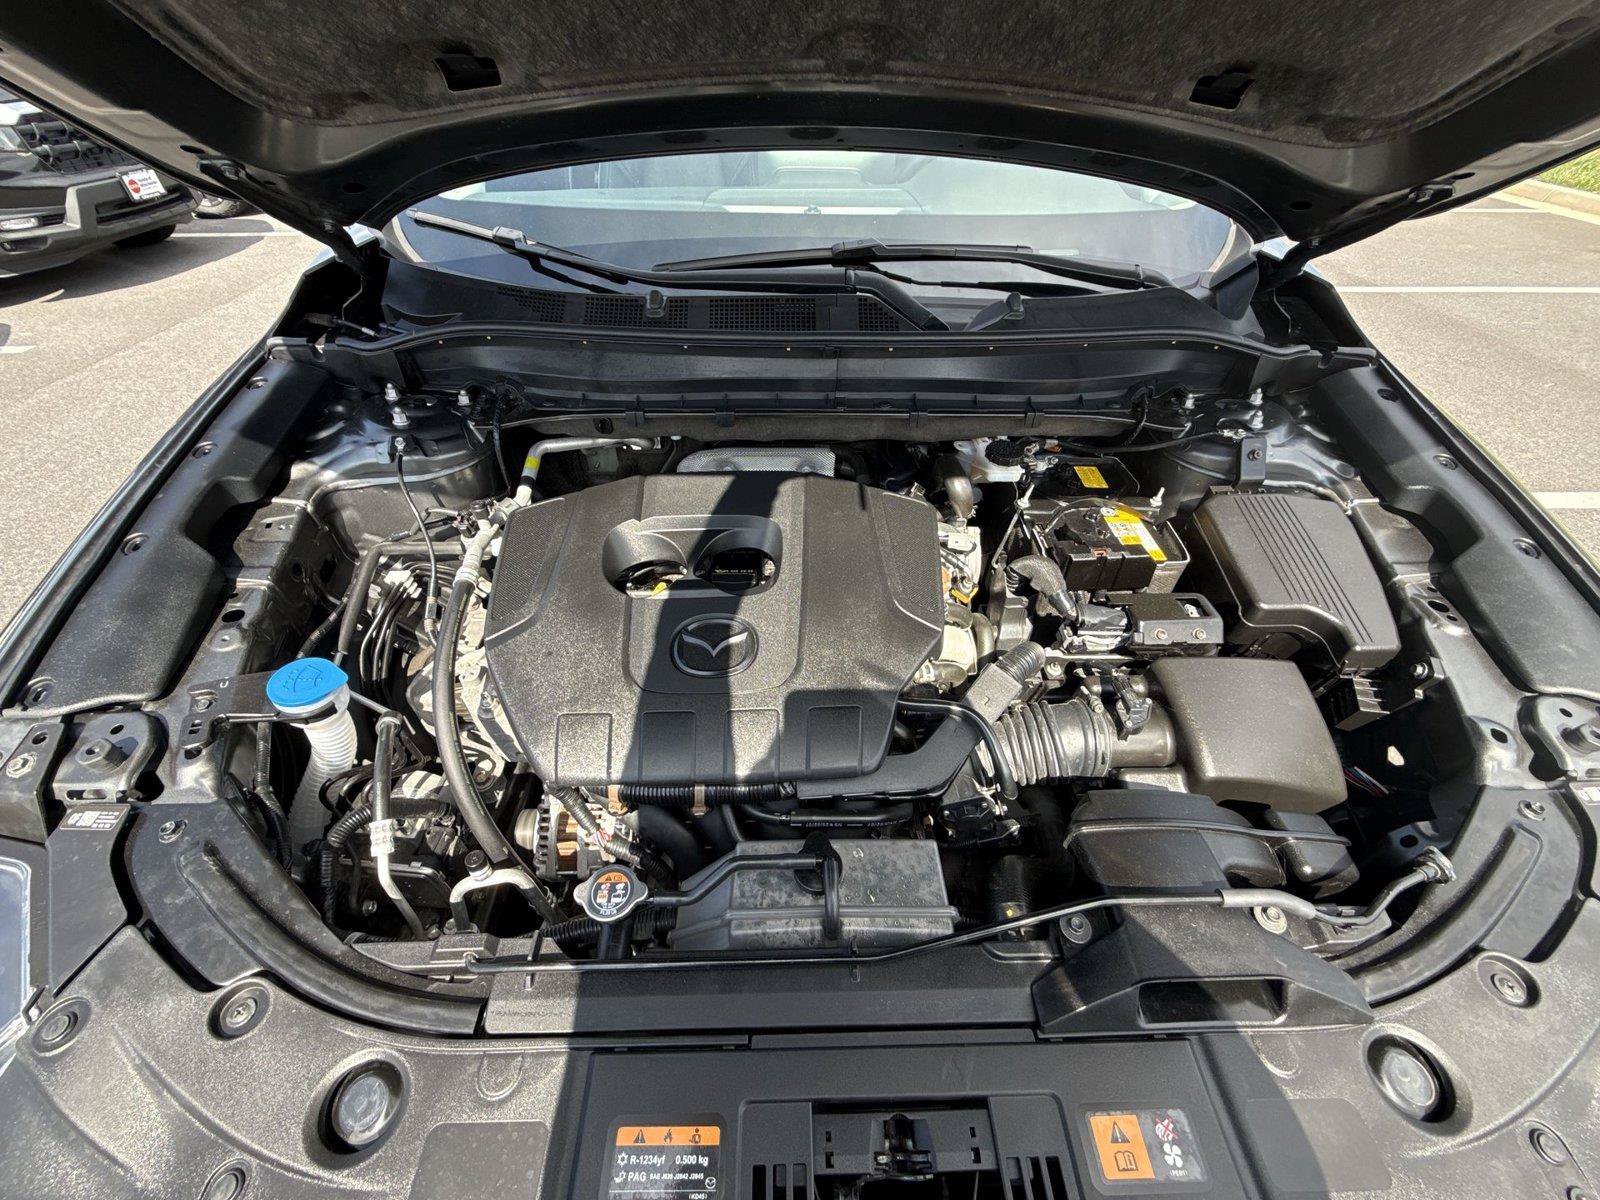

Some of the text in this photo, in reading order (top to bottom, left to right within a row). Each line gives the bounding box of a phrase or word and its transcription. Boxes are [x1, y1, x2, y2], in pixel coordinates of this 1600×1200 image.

[629, 1155, 709, 1167] R-1234yf 0.500 kg
[627, 1171, 647, 1182] PAG
